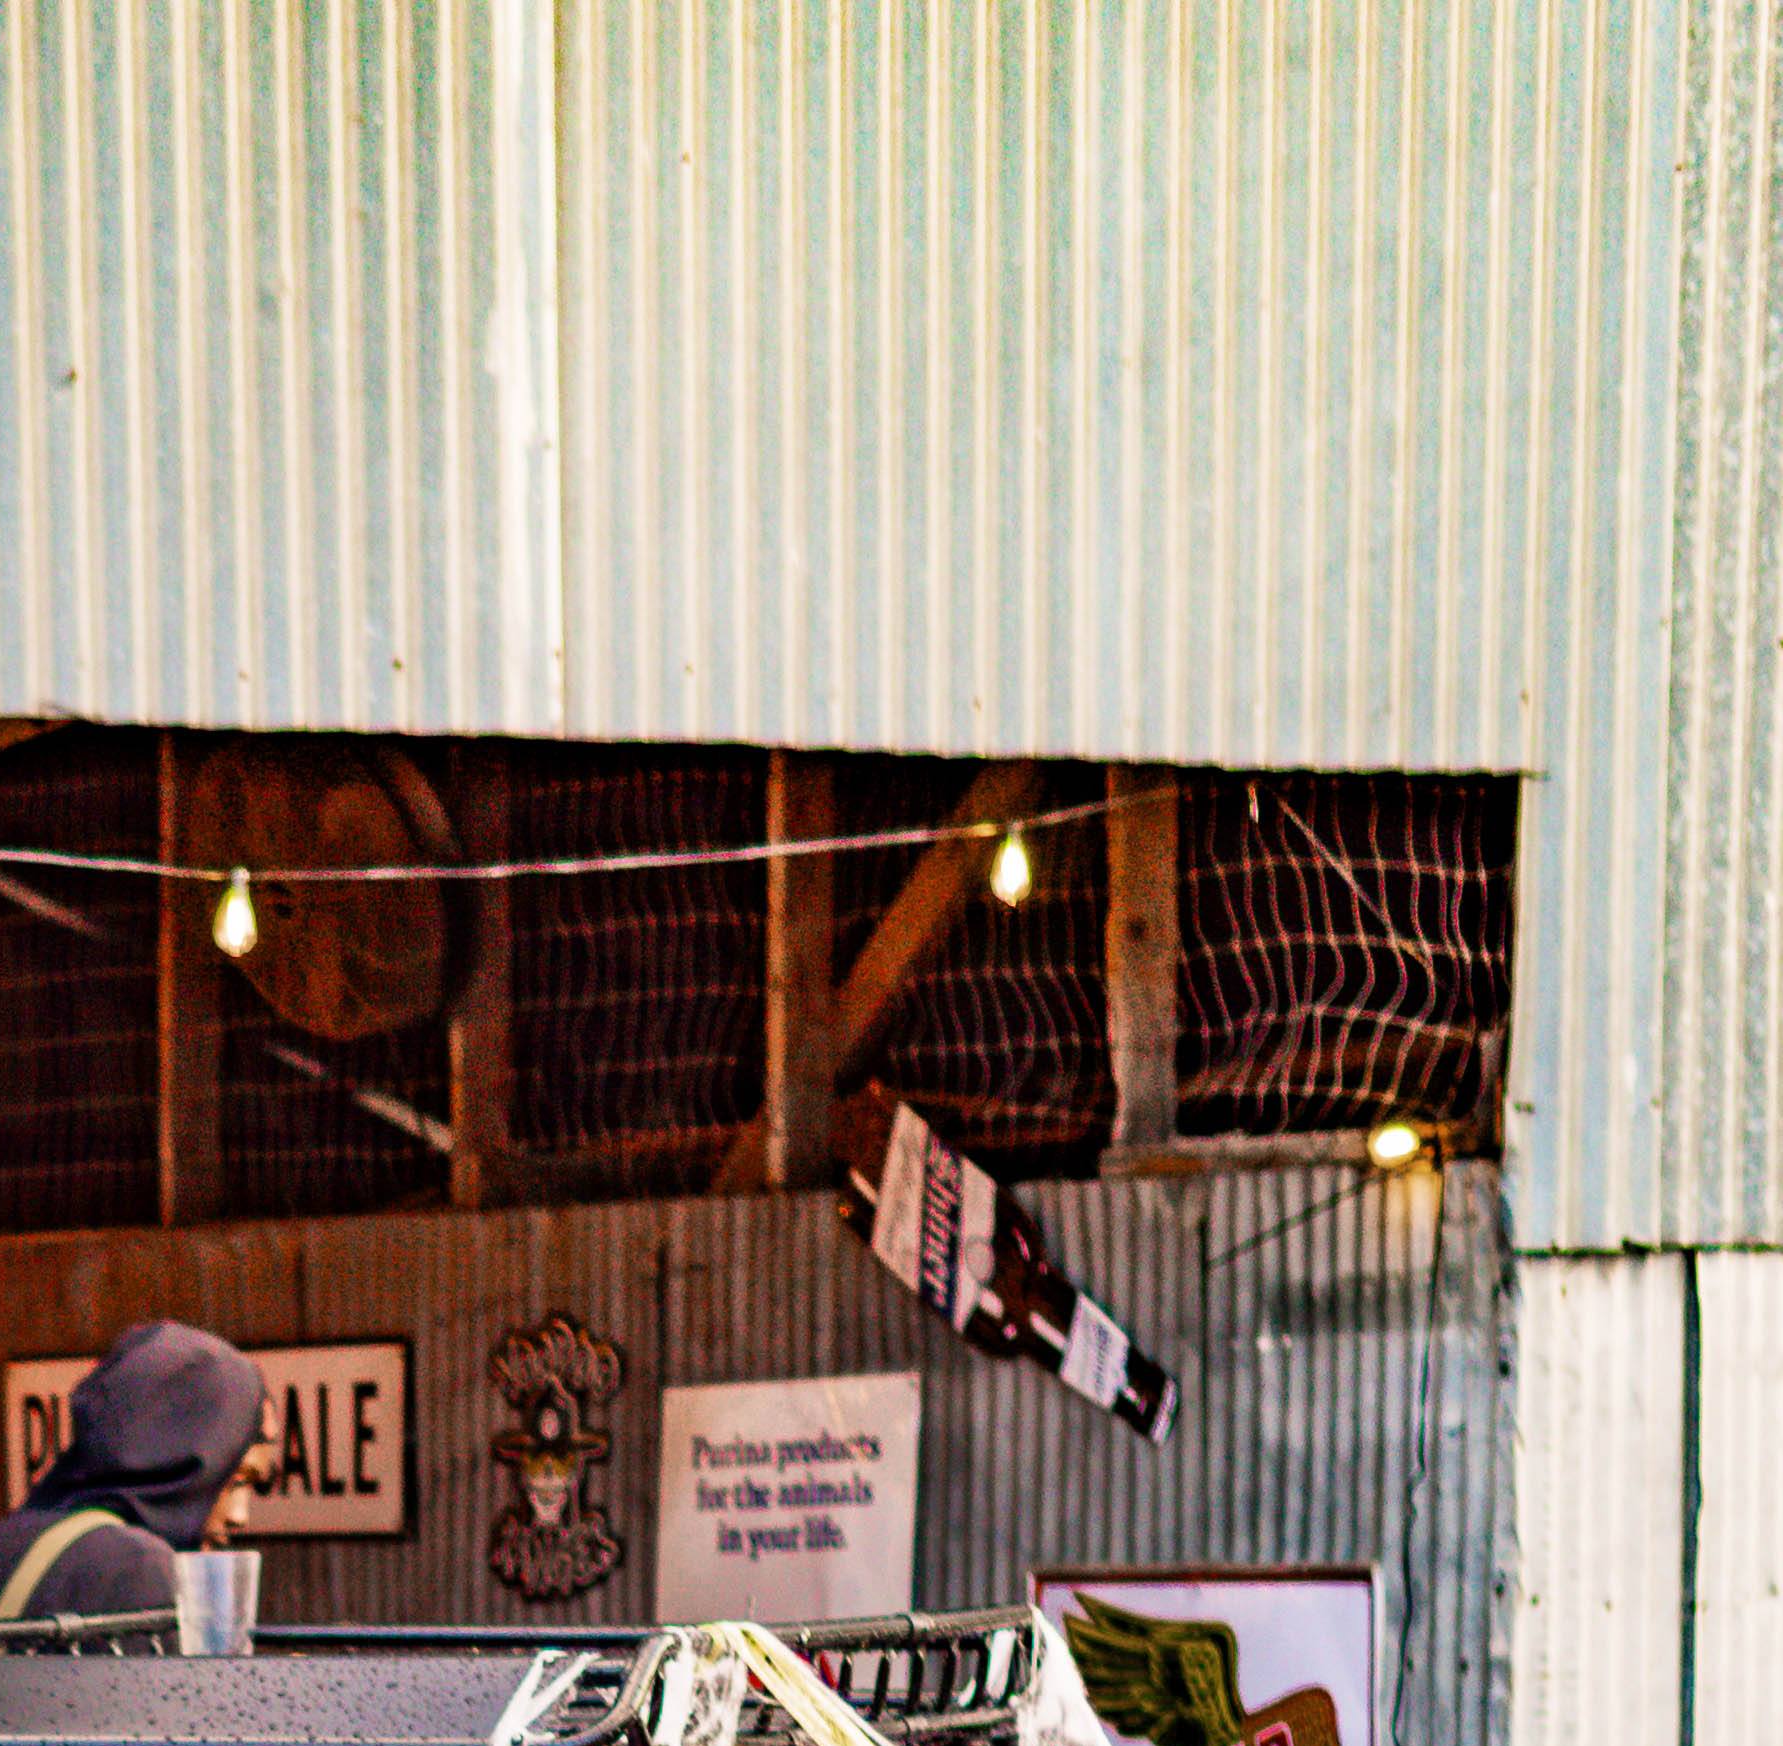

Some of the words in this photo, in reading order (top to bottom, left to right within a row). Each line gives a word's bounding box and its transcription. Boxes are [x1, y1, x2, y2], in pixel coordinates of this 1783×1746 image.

[252, 1382, 381, 1497] ALE
[692, 1433, 773, 1471] Purina
[776, 1427, 881, 1473] products
[697, 1478, 729, 1512] for
[734, 1475, 771, 1509] the
[778, 1472, 874, 1507] animals
[718, 1518, 743, 1553] in
[748, 1524, 801, 1562] your
